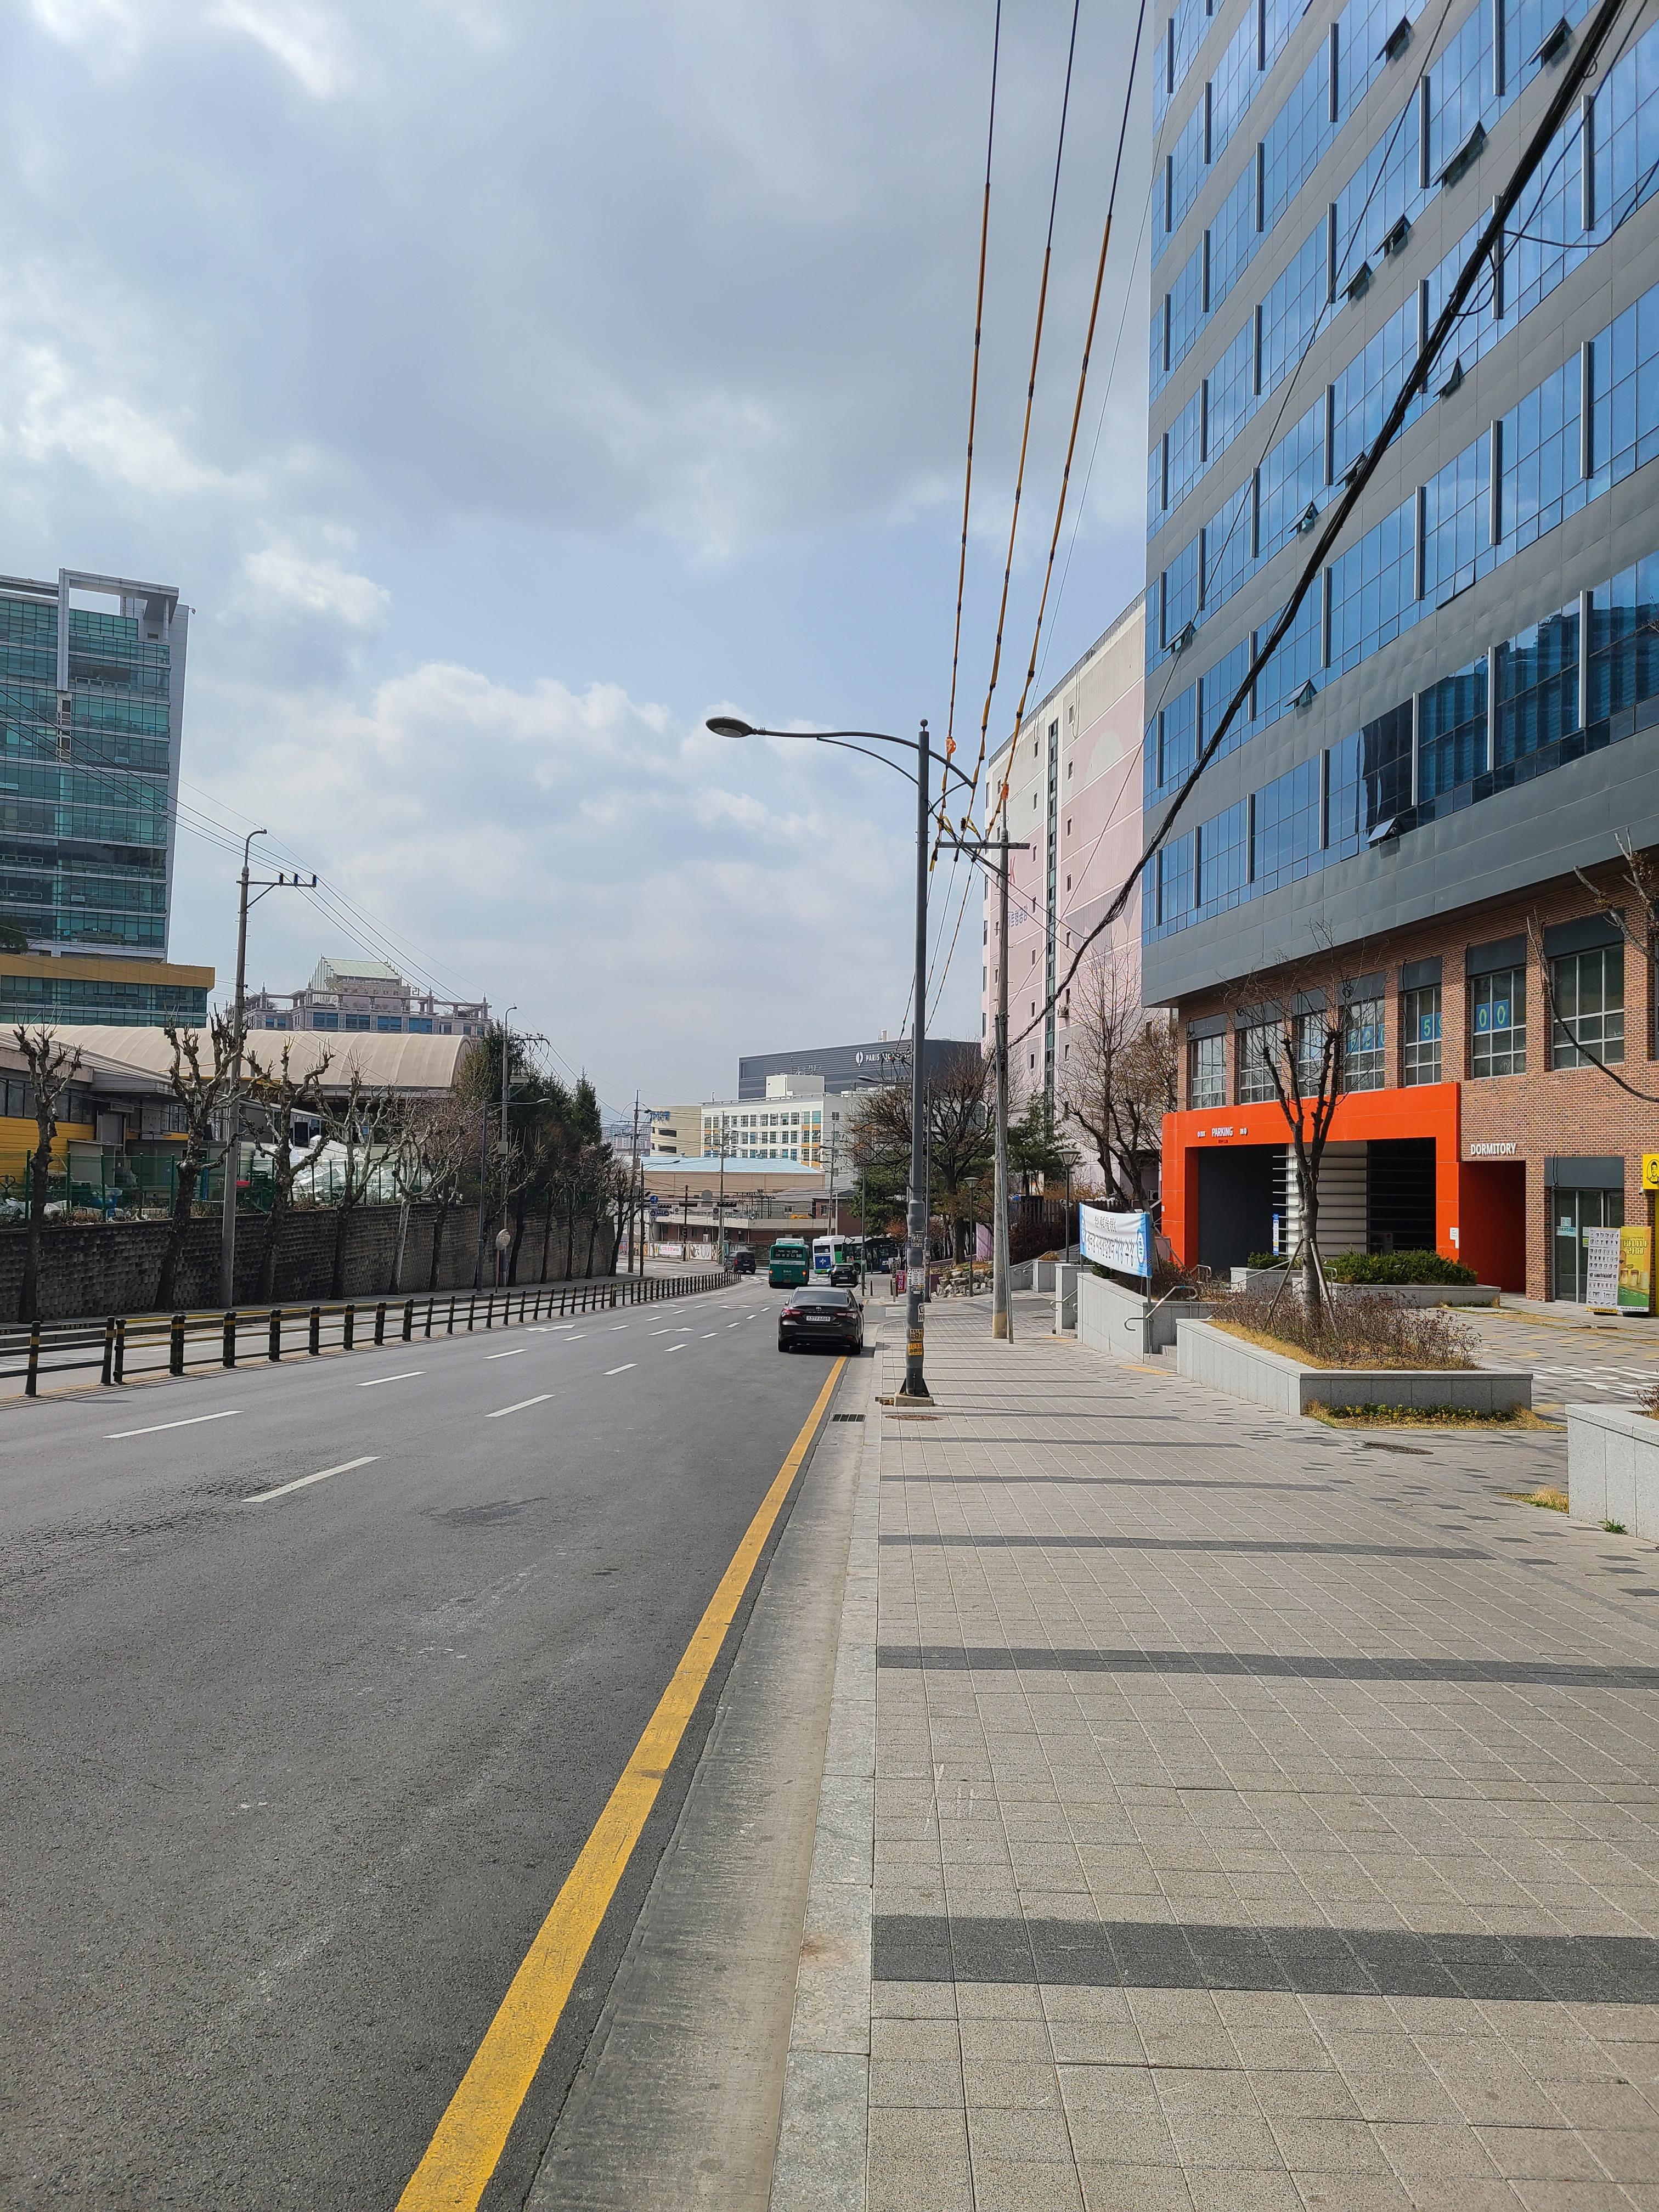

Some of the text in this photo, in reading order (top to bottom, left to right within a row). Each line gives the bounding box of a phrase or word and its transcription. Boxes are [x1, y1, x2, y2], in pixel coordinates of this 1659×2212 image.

[866, 1053, 880, 1062] PARIS
[1211, 1126, 1234, 1137] PARKING
[1471, 1143, 1517, 1155] DORMITORY
